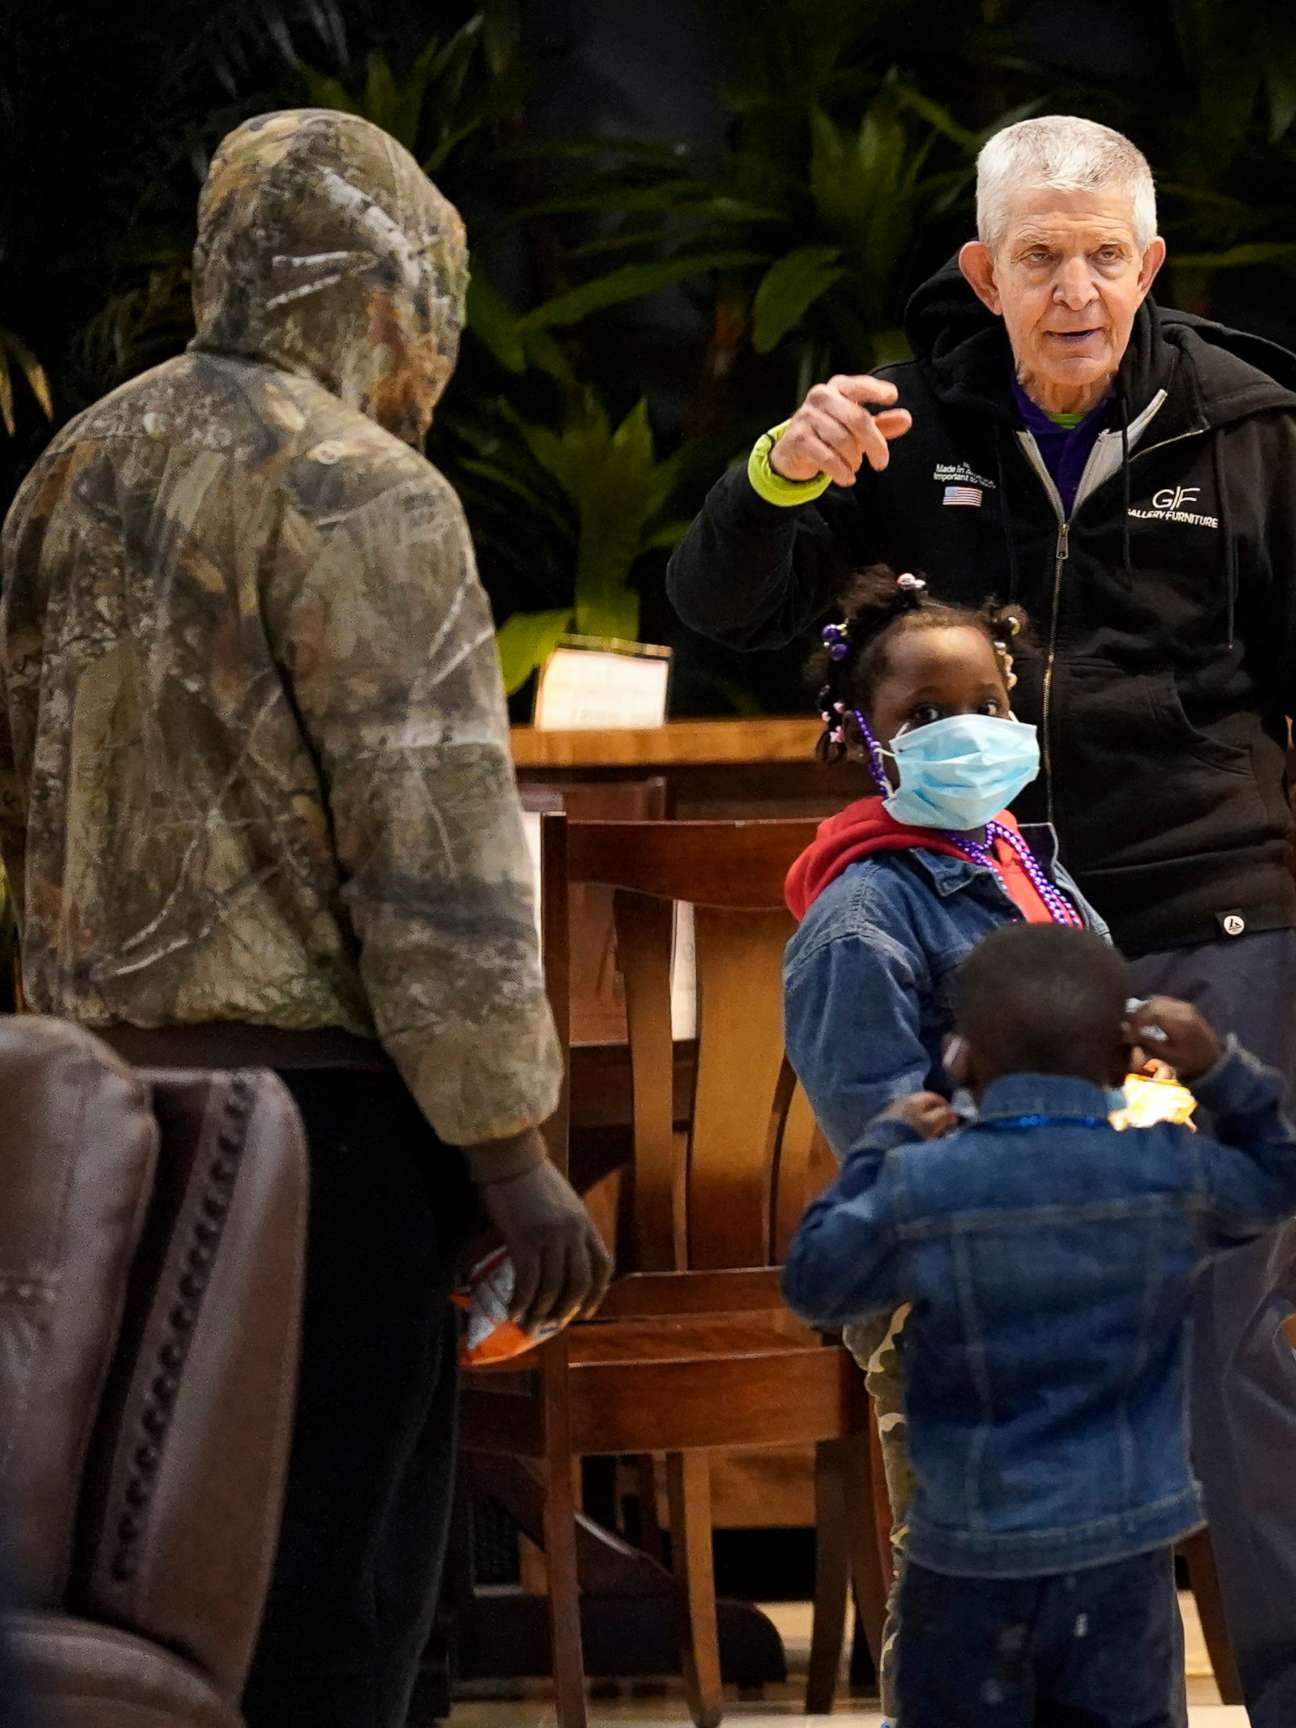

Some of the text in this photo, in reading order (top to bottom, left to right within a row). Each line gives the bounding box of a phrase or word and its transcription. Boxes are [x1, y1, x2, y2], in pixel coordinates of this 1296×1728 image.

[936, 463, 956, 473] Made
[956, 464, 966, 473] in
[933, 472, 969, 482] Important
[1165, 510, 1219, 529] FURNITURE
